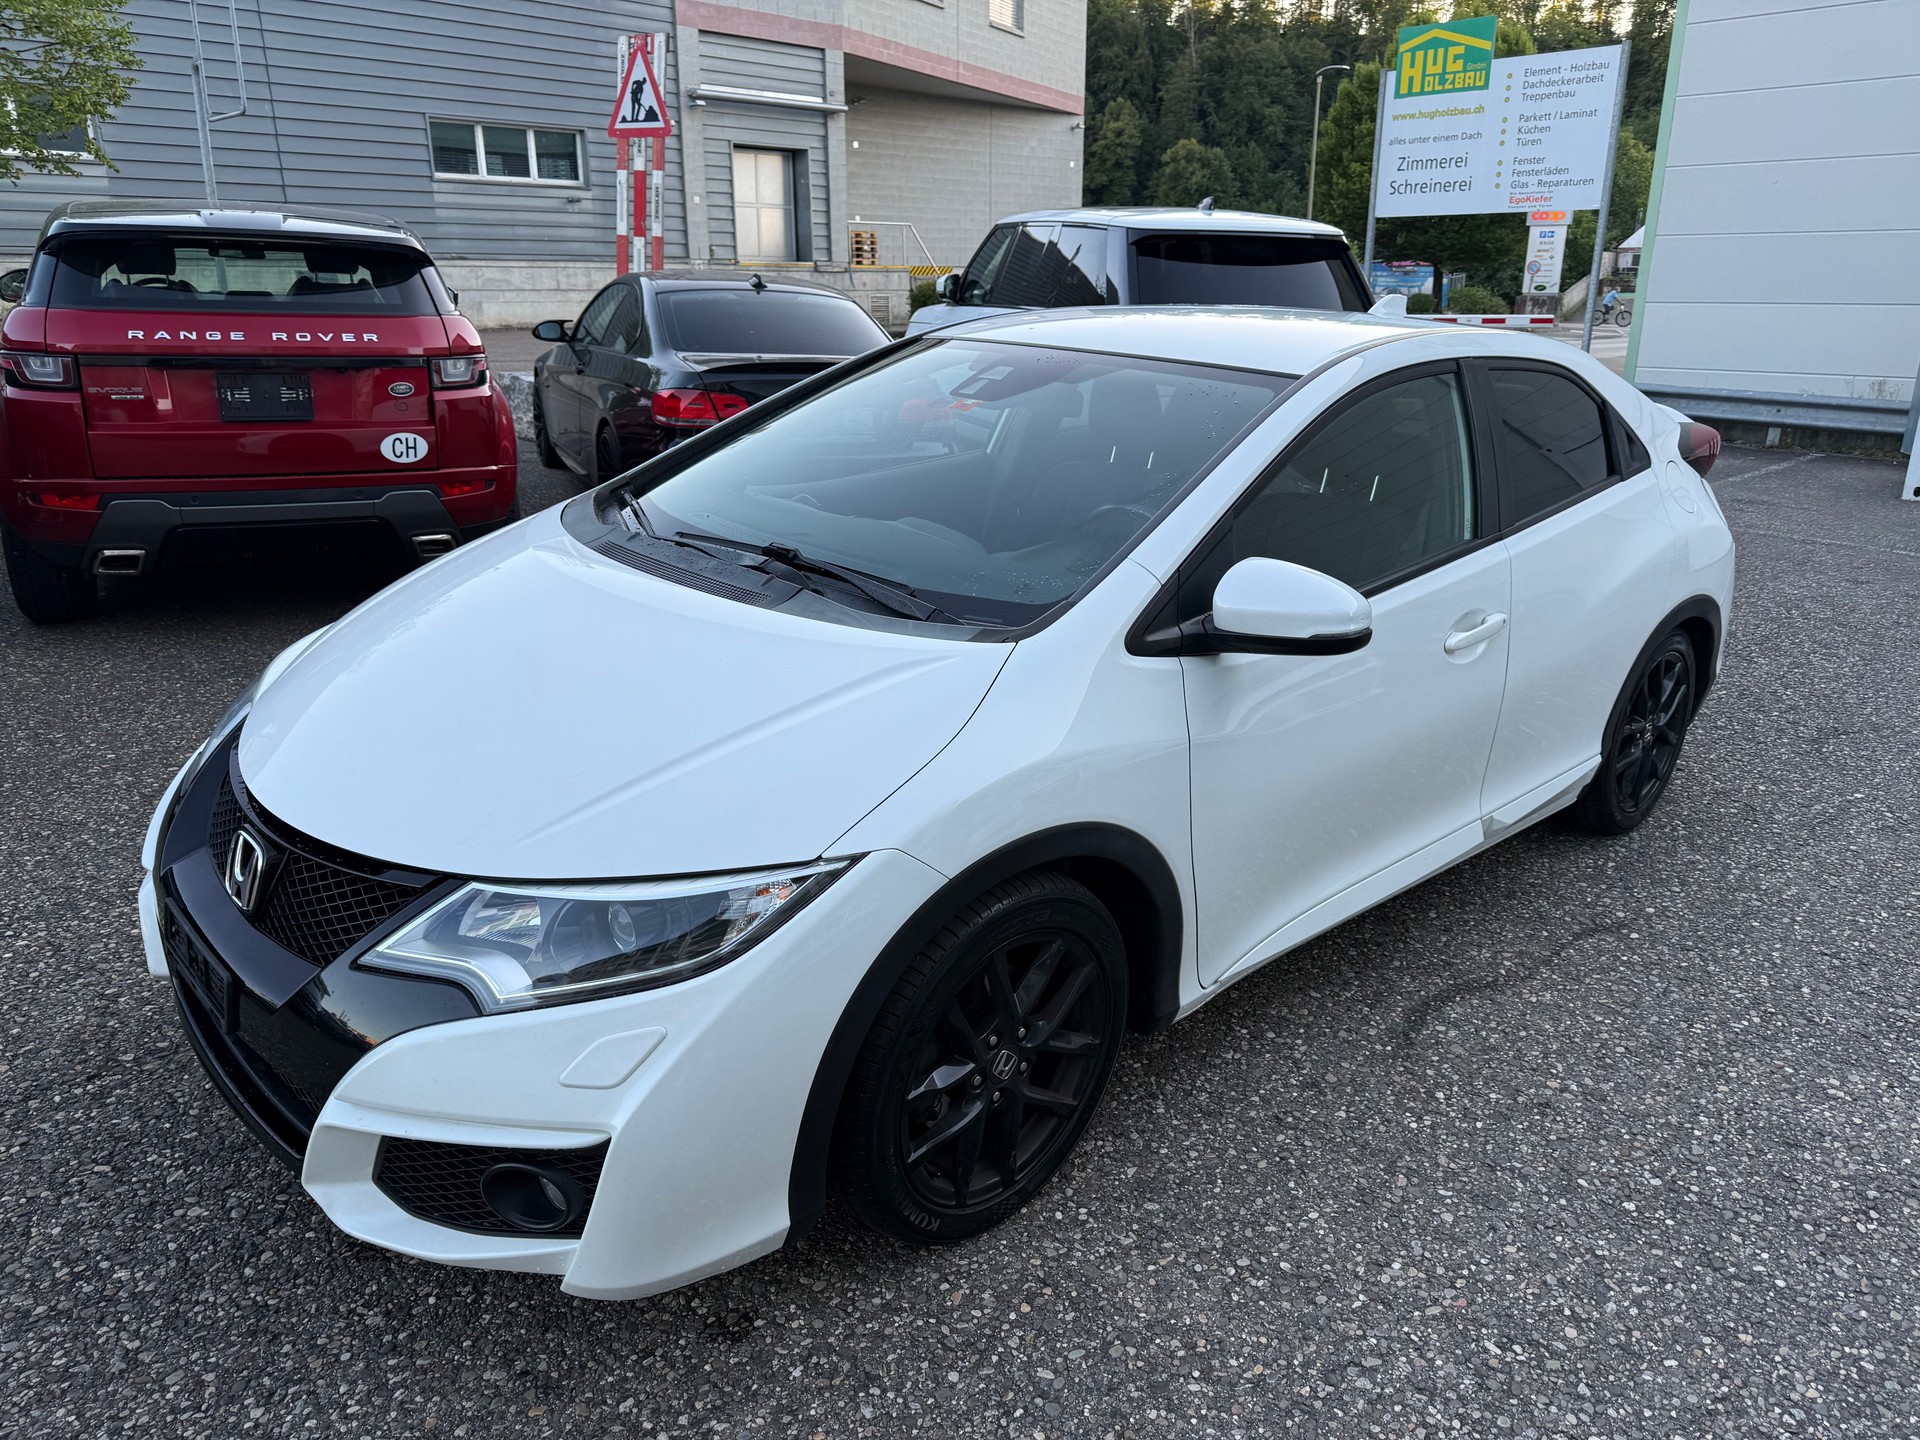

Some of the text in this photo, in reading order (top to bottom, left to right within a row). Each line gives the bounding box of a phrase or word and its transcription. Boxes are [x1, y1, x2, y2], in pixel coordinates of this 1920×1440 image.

[1466, 62, 1487, 70] GmbH
[1524, 67, 1561, 77] Element
[1570, 60, 1610, 73] Holzbau
[1522, 73, 1604, 90] Dachdeckerarbeit
[1521, 89, 1576, 103] Treppenbau
[1392, 104, 1485, 121] www.hugholzbau.ch
[1519, 112, 1552, 123] Parkett
[1560, 108, 1598, 120] Laminat
[1517, 124, 1551, 135] Küchen
[1388, 131, 1482, 146] alles unter einem Dach
[1516, 138, 1542, 147] Türen
[1397, 152, 1469, 172] Zimmerei
[1513, 156, 1546, 166] Fenster
[1512, 166, 1570, 177] Fensterläden
[1389, 176, 1473, 195] Schreinerei
[1510, 180, 1529, 189] Glas
[1537, 177, 1595, 189] Reparaturen
[1509, 195, 1553, 205] EgoKiefer
[1531, 211, 1567, 223] coop
[128, 330, 379, 342] RANGE ROVER
[392, 437, 417, 458] CH
